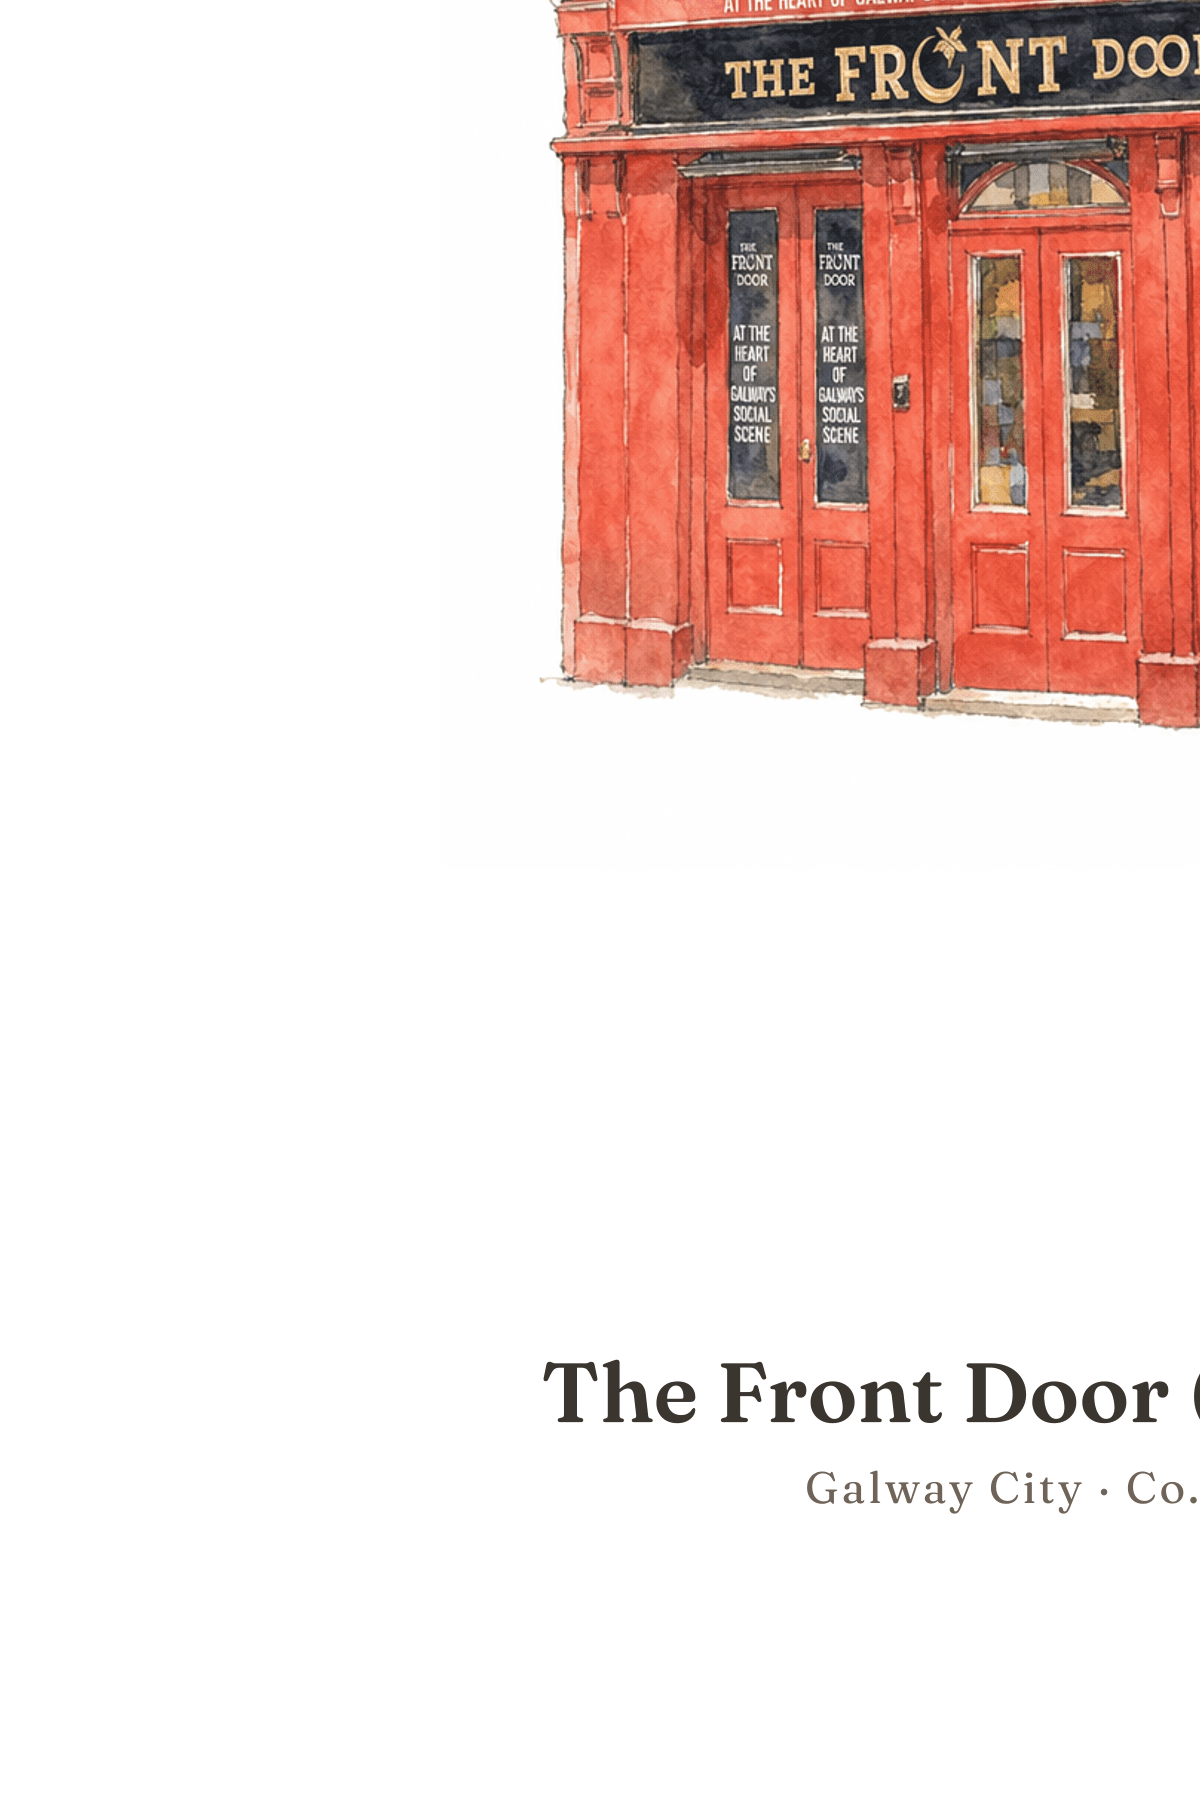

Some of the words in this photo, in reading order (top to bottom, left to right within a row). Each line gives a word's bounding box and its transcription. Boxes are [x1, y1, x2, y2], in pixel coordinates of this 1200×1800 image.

[725, 57, 815, 100] THE
[834, 25, 1068, 104] FRONT
[737, 273, 769, 287] DOOR
[824, 273, 856, 287] DOOR
[733, 324, 746, 342] AT
[748, 324, 771, 342] THE
[821, 325, 834, 343] AT
[837, 325, 859, 343] THE
[735, 345, 770, 362] HEART
[823, 345, 858, 363] HEART
[742, 365, 758, 382] OF
[832, 366, 847, 383] OF
[733, 405, 772, 423] SOCIAL
[821, 406, 861, 424] SOCIAL
[734, 425, 771, 443] SCENE
[822, 426, 859, 444] SCENE
